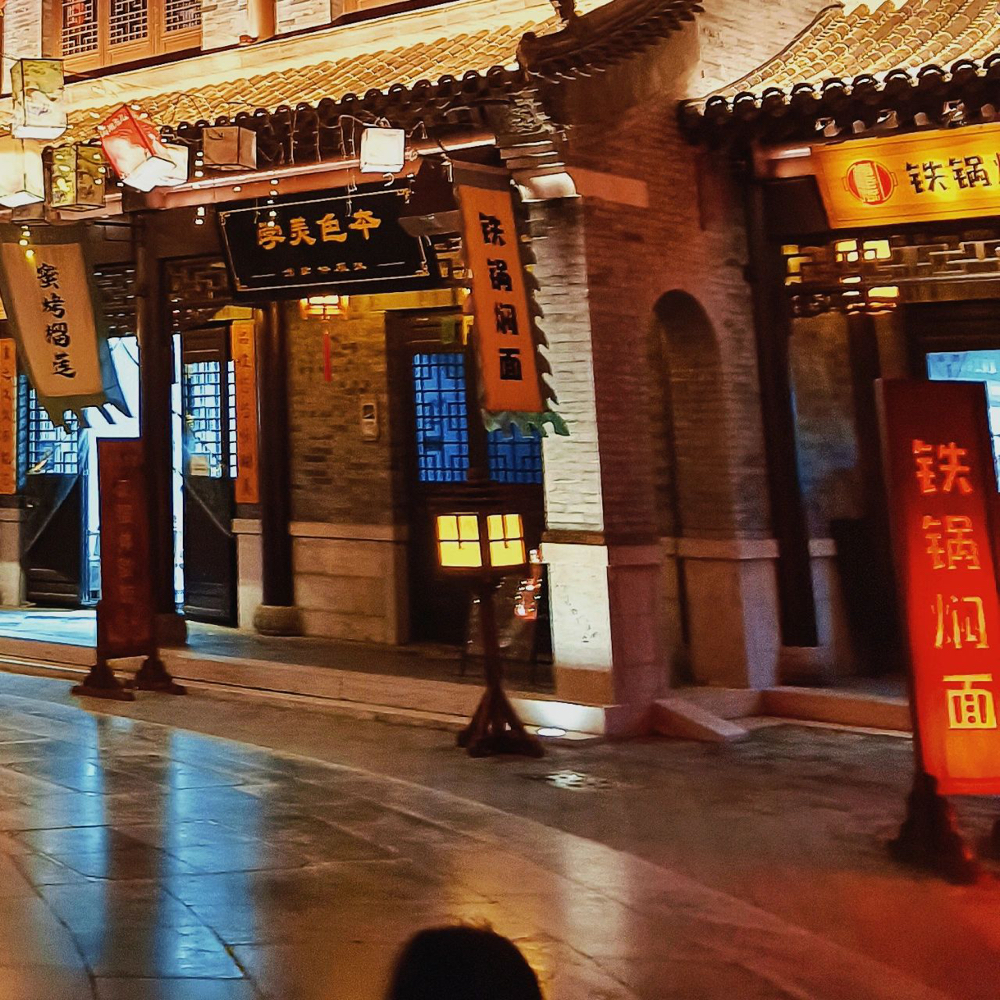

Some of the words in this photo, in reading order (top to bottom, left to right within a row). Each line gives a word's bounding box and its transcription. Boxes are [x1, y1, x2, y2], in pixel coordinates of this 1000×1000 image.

[905, 151, 1000, 193] 铁锅
[911, 439, 999, 730] 铁锅焖面
